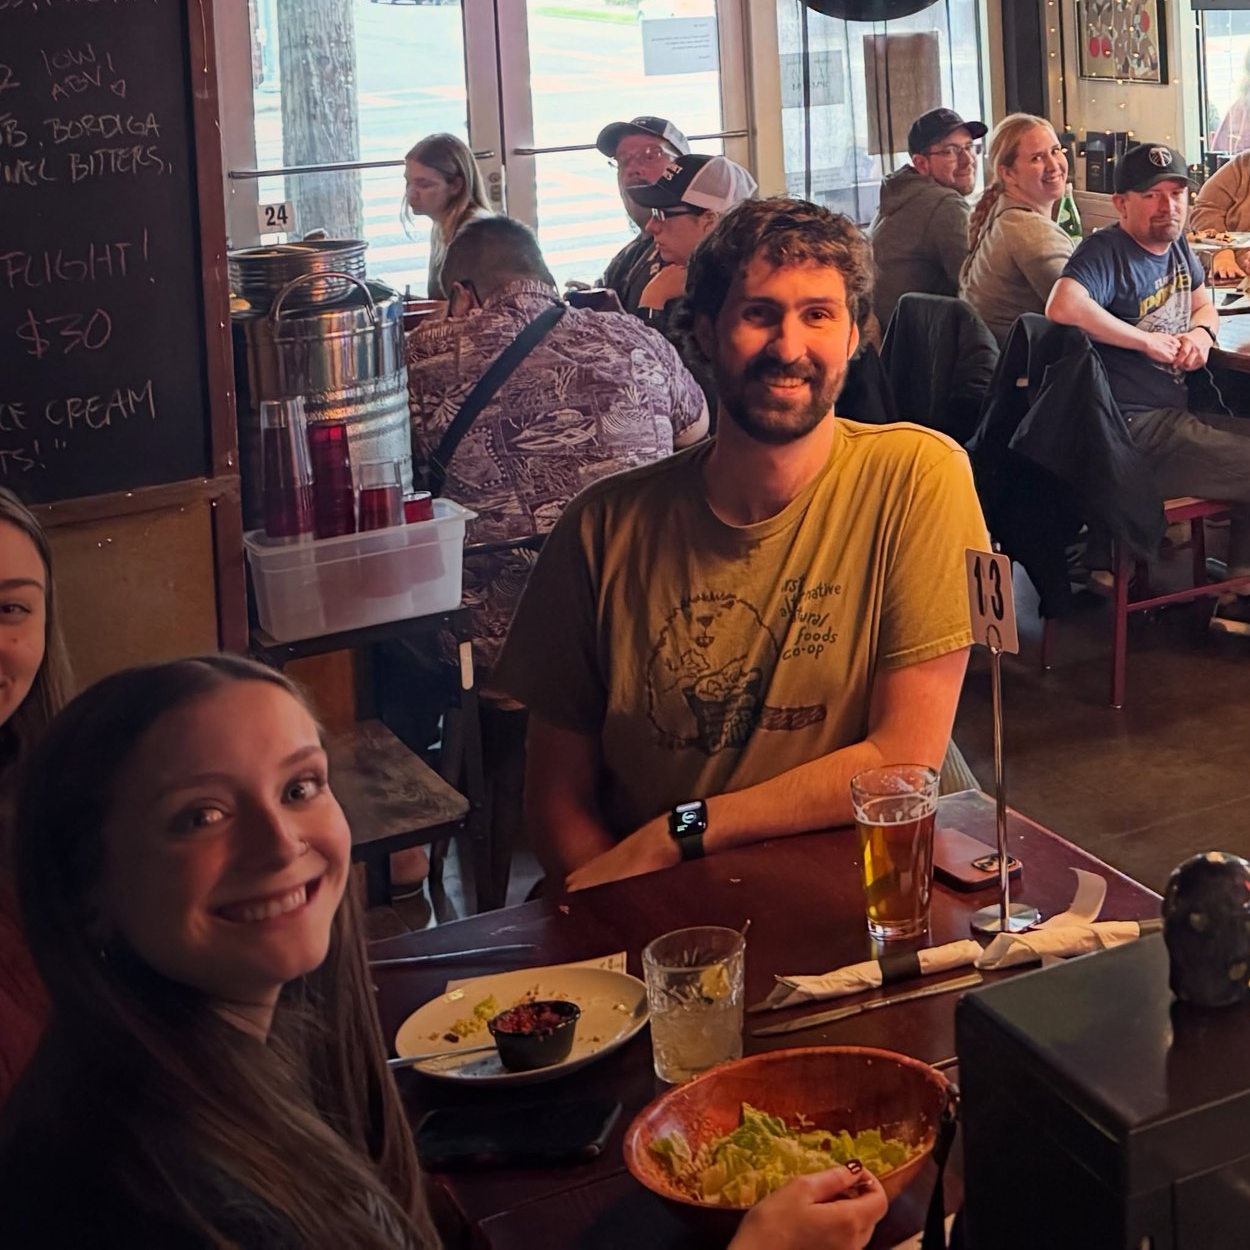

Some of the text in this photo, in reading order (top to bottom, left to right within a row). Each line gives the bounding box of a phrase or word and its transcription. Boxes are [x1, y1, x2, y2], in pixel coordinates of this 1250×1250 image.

[265, 204, 288, 226] 24
[16, 308, 112, 358] $30
[45, 379, 156, 430] CREAM
[974, 556, 1004, 621] 13
